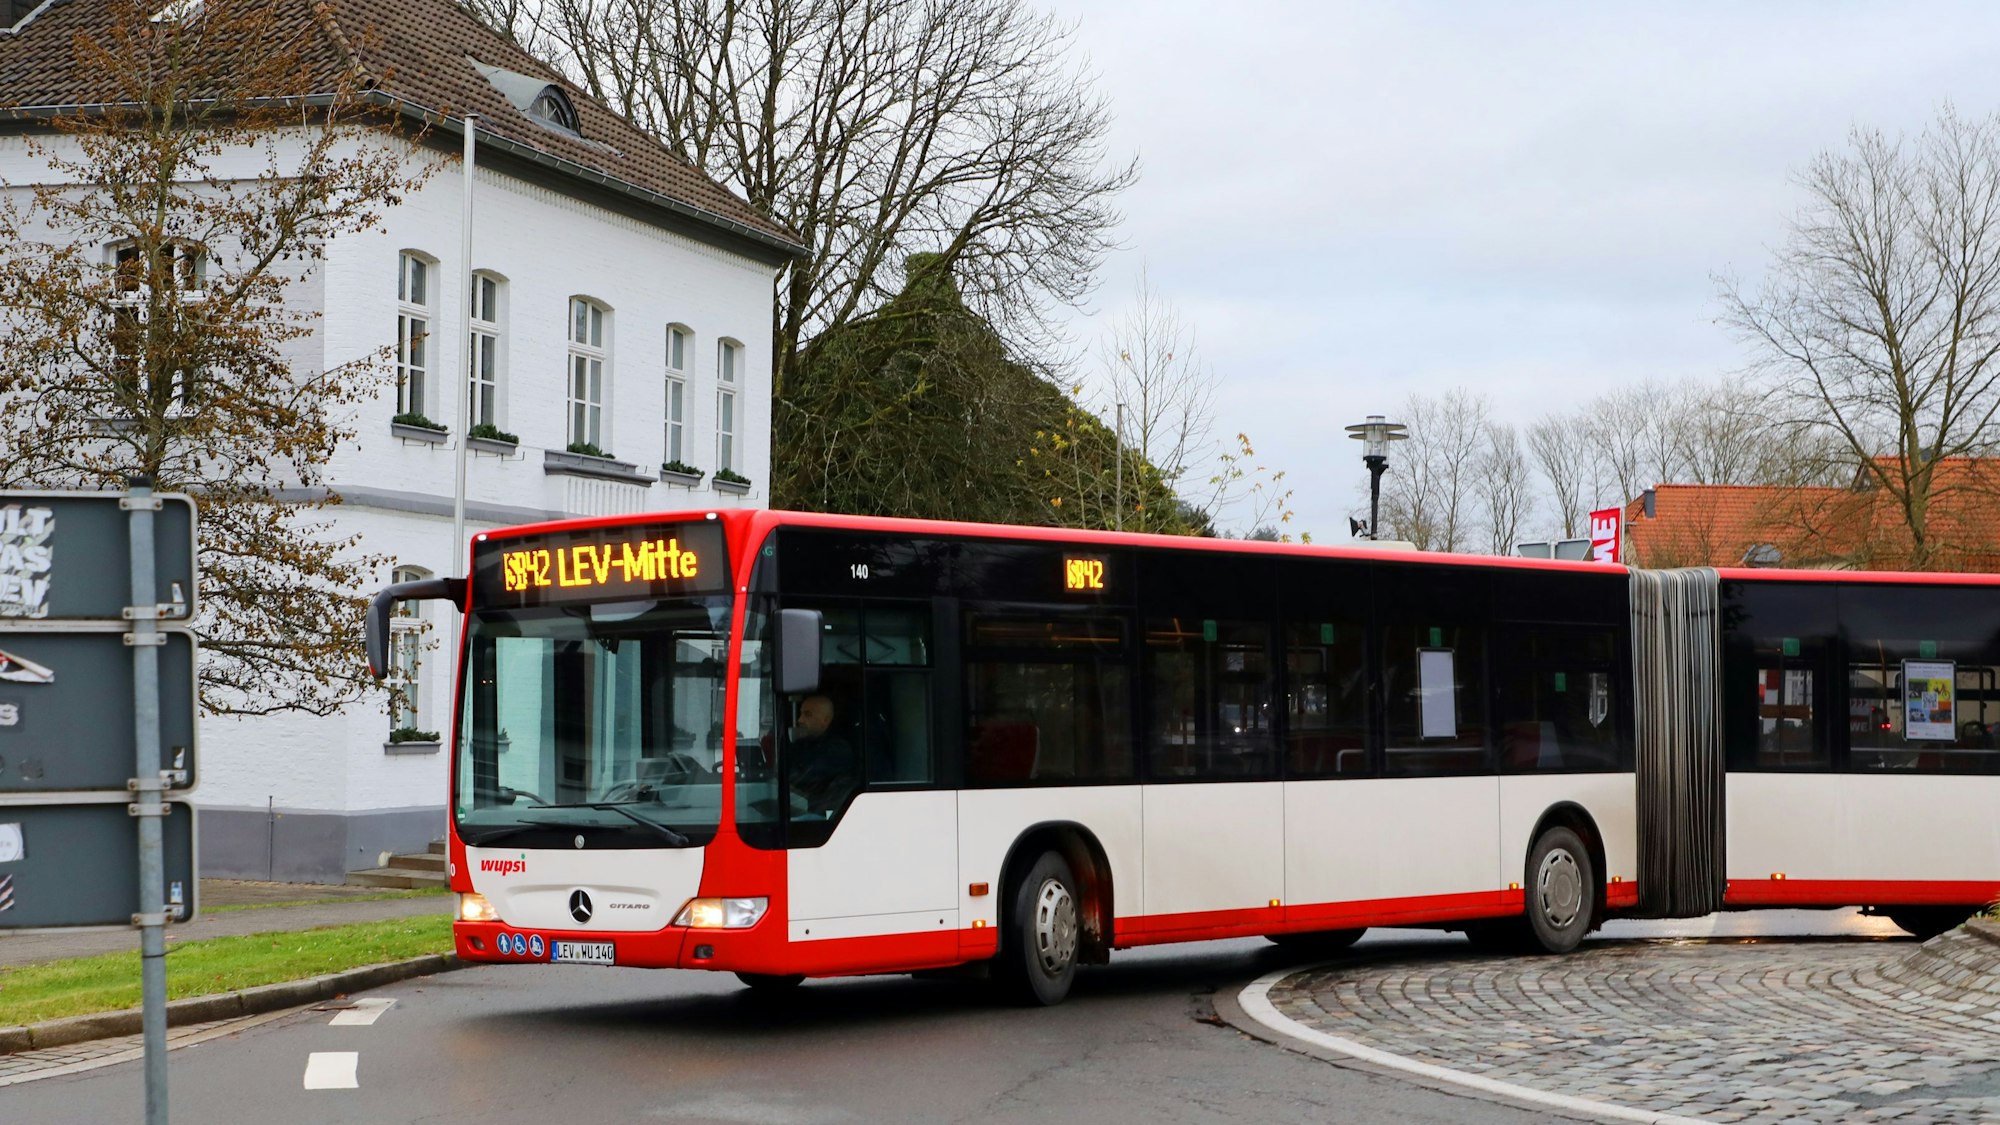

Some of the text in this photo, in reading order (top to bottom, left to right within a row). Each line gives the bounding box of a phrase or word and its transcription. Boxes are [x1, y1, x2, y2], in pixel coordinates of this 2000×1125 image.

[0, 507, 54, 538] LT
[0, 543, 52, 572] AS
[556, 537, 698, 587] LEV-Mitte
[850, 563, 869, 579] 140
[481, 853, 526, 876] wupsi
[557, 944, 575, 959] LEV
[581, 944, 594, 959] WU
[595, 945, 613, 960] 140
